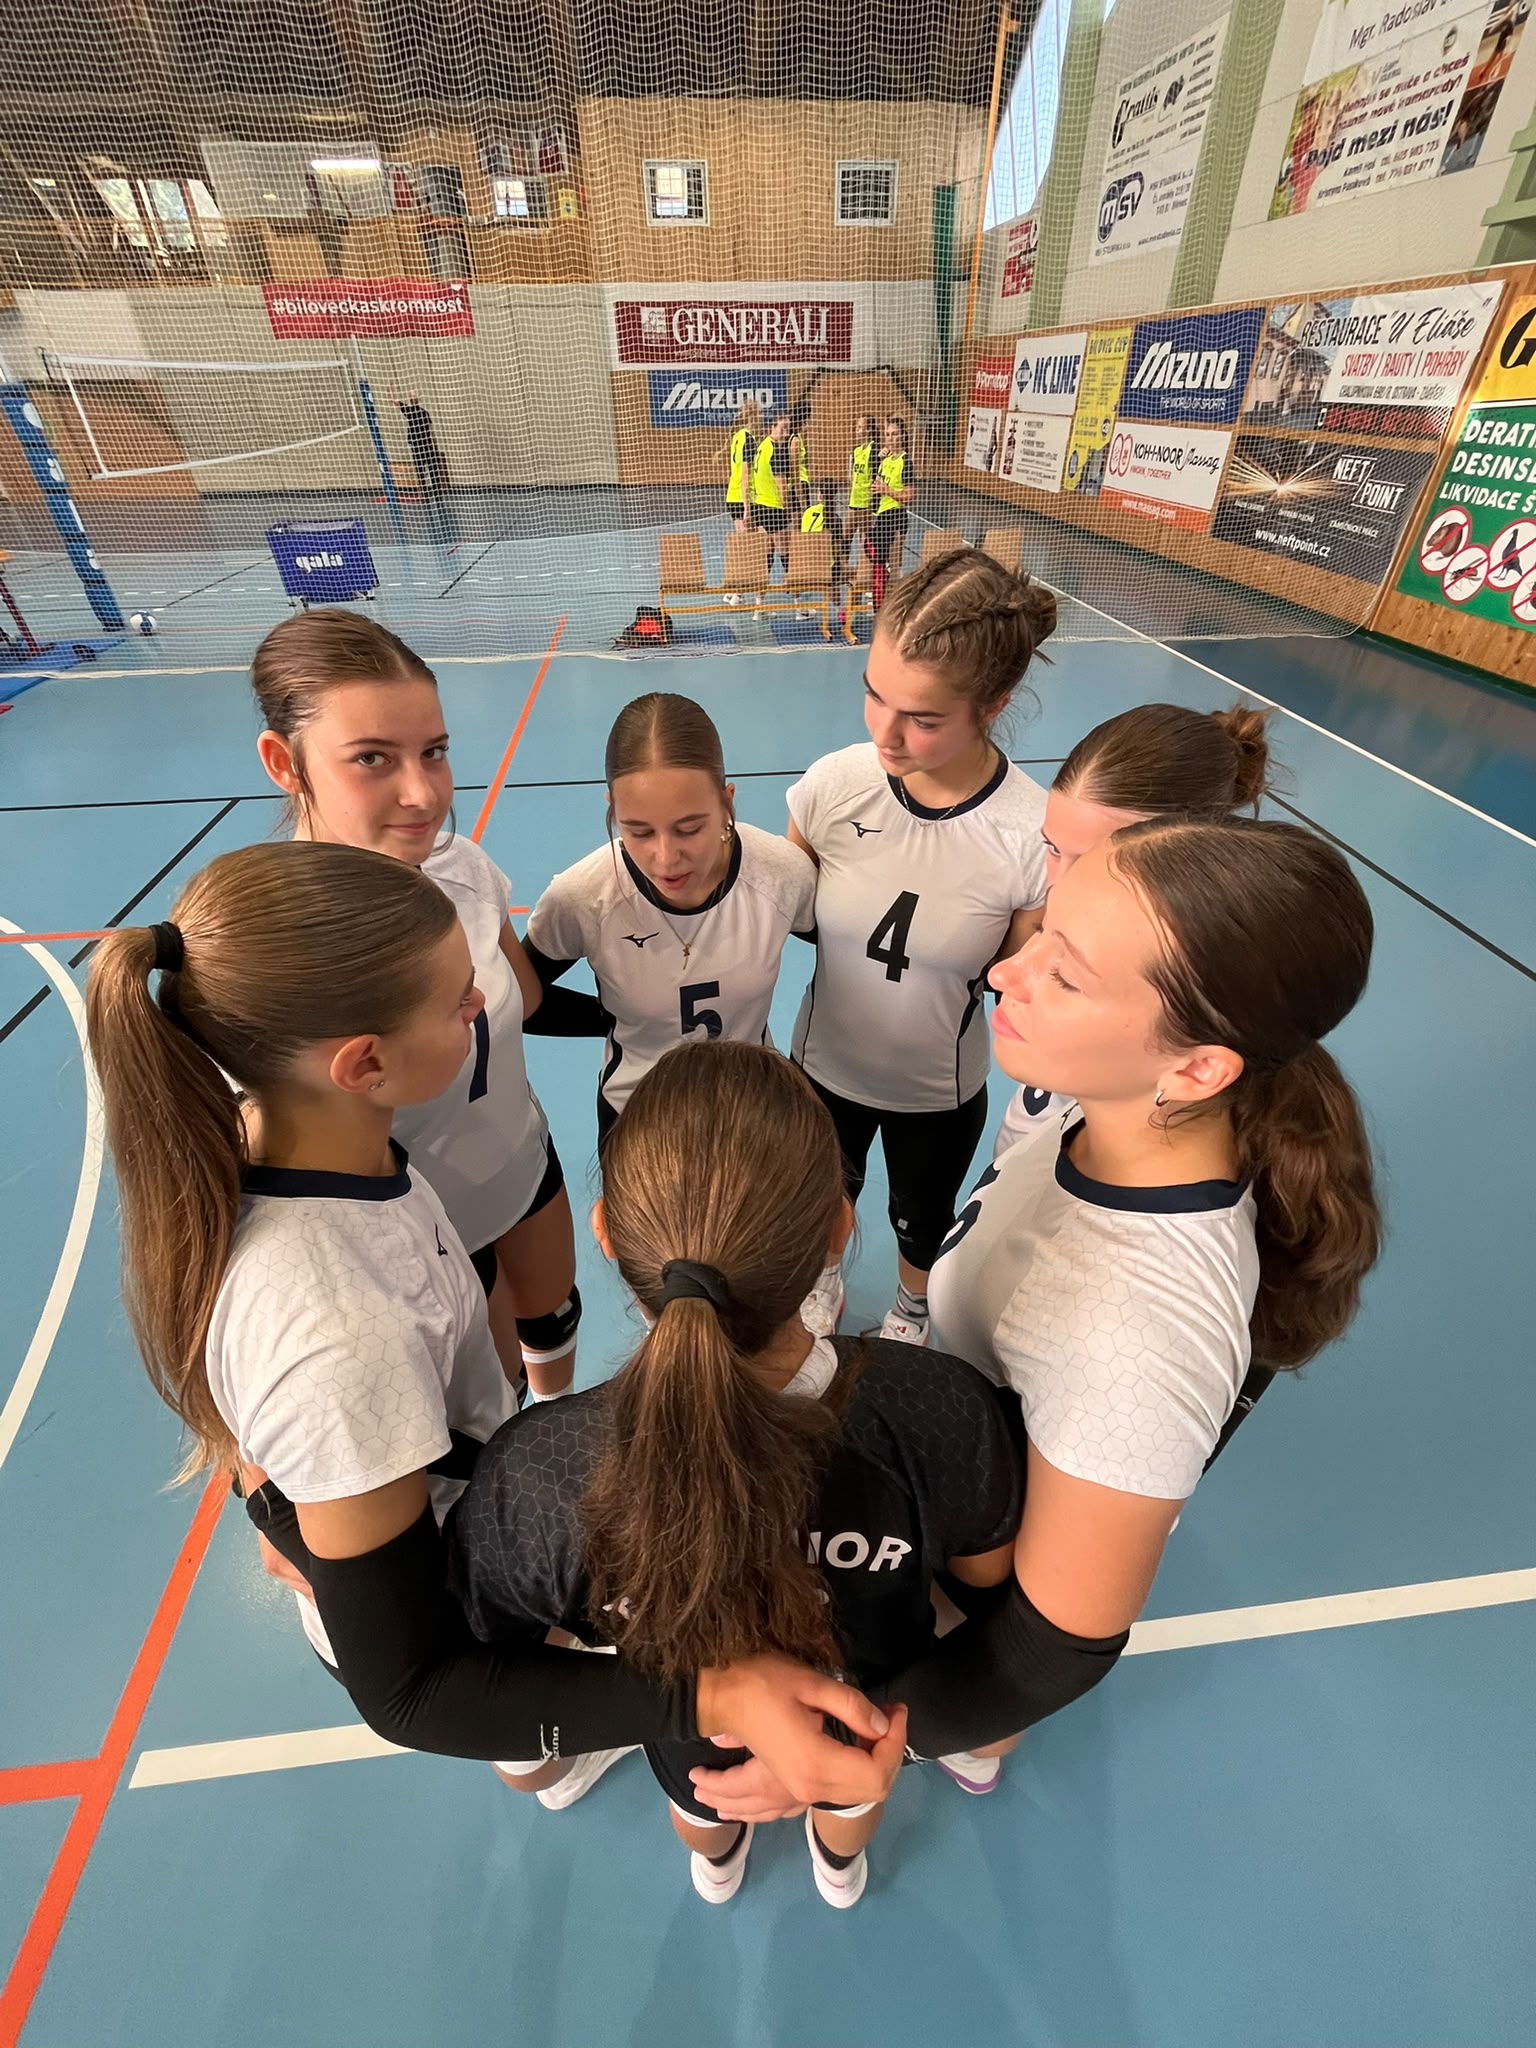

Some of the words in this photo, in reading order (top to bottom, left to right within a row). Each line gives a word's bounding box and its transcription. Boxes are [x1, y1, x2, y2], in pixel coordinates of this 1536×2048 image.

[1349, 23, 1376, 50] Mgr.
[1379, 0, 1437, 36] Radoslav
[1347, 119, 1398, 157] mezi
[672, 307, 830, 345] GENERALI
[1300, 314, 1387, 347] RESTAURACE
[1341, 353, 1379, 377] SVATBY
[1332, 457, 1370, 483] NEFT
[1360, 482, 1405, 511] POINT
[1439, 481, 1522, 511] LIKVIDACE
[1255, 527, 1331, 558] www.neftpoint.cz
[295, 551, 344, 574] gala
[866, 890, 920, 983] 4
[680, 980, 724, 1041] 5
